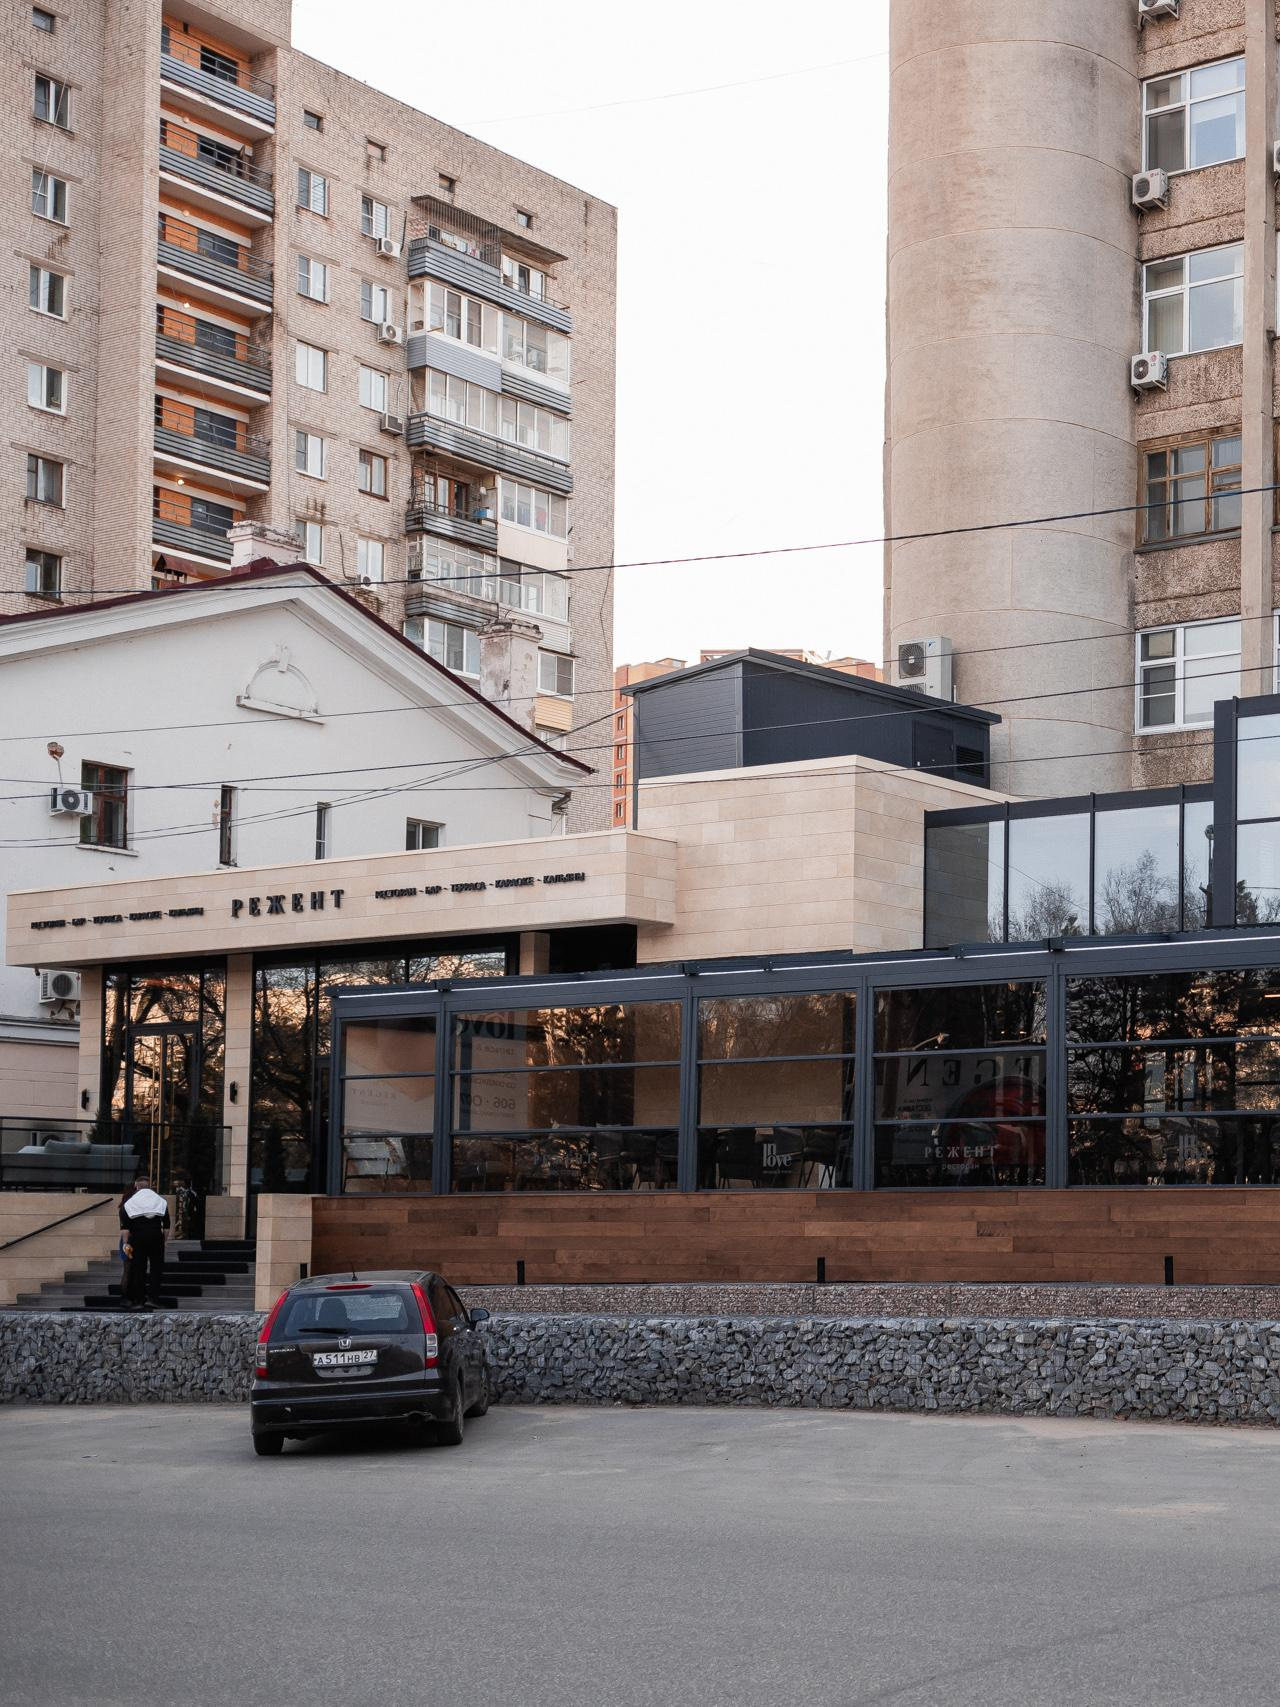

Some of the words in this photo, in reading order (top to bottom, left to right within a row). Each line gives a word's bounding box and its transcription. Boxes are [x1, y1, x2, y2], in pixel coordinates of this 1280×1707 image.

[495, 876, 534, 889] КАРАОКЕ
[231, 889, 344, 918] РЕЖЕНТ
[924, 1146, 995, 1158] РЕЖЕНТ
